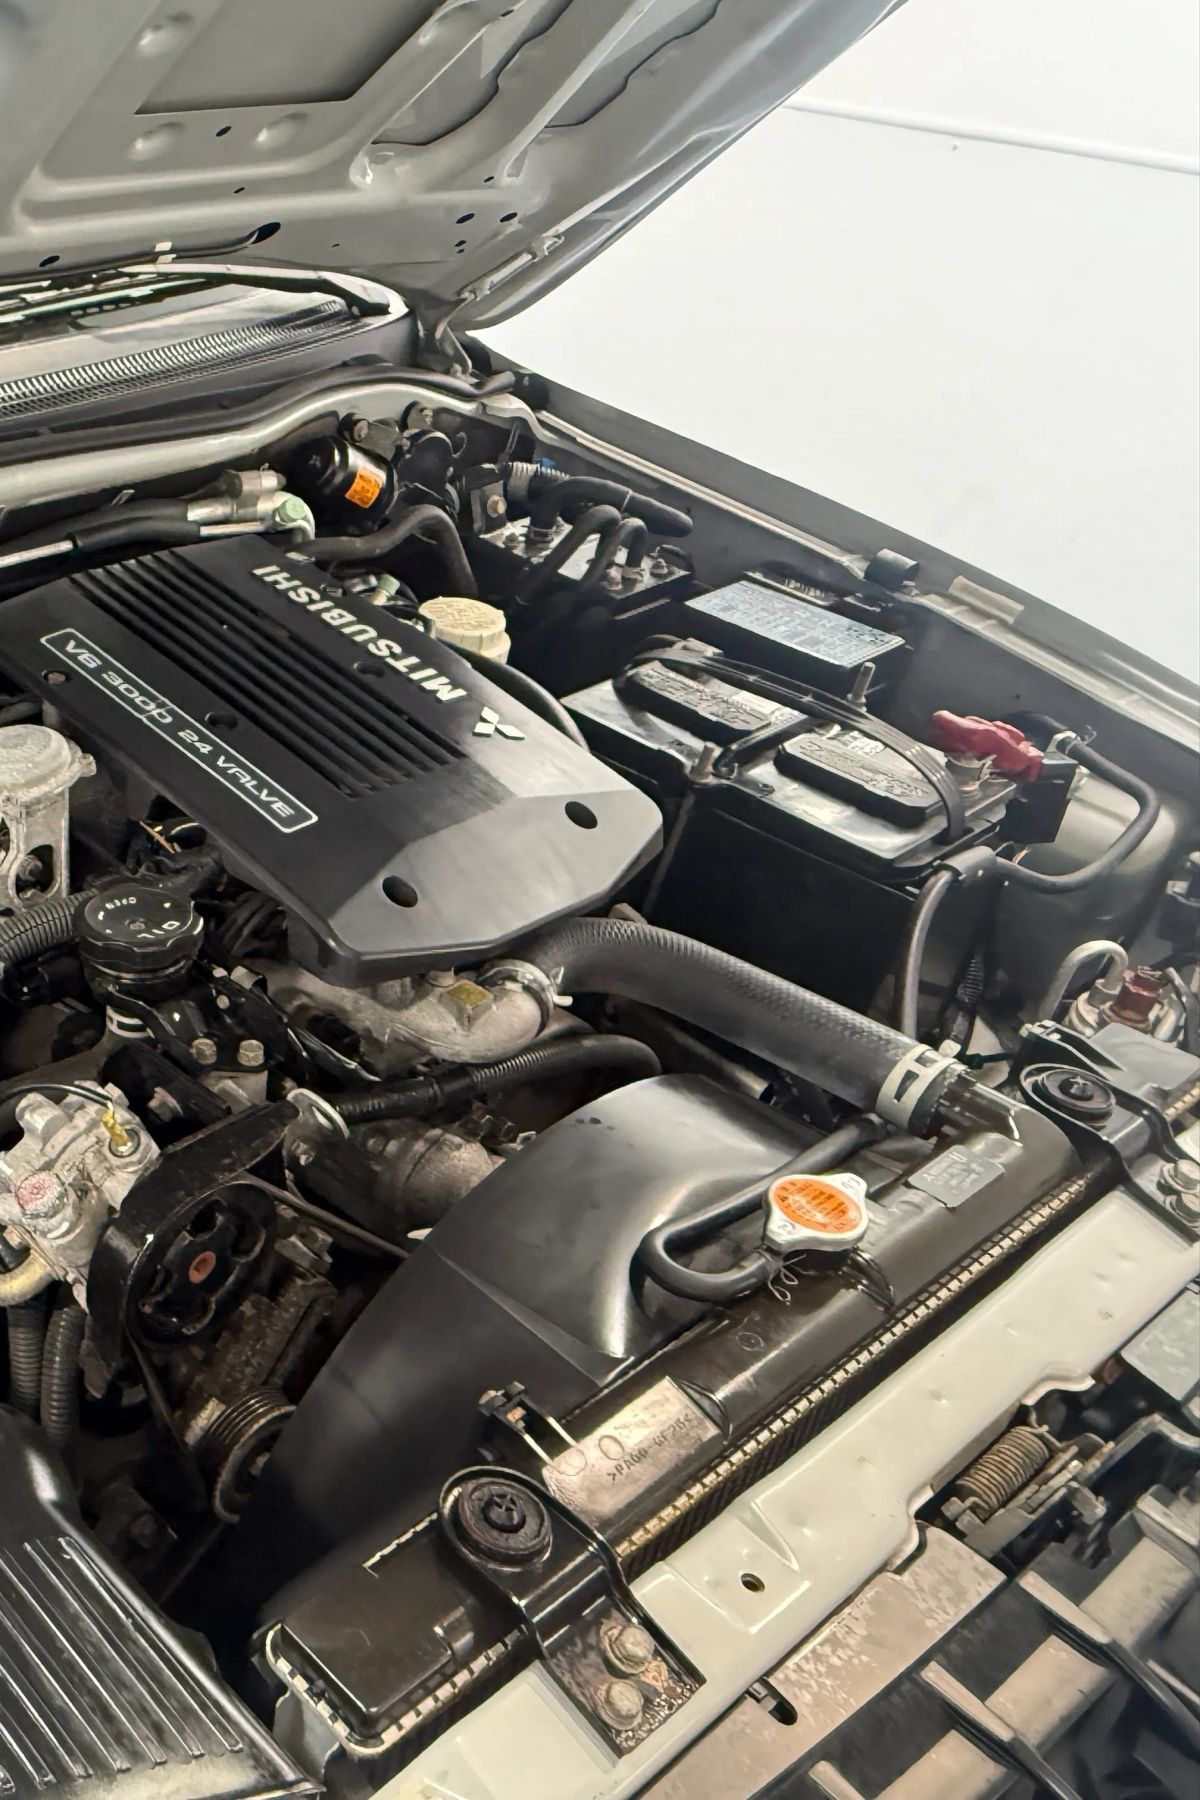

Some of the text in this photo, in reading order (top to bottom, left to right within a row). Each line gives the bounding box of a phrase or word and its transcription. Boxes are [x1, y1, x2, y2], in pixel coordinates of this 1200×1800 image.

[251, 564, 468, 703] MITSUBISHI
[65, 639, 296, 818] V6 3000 24 VALVE
